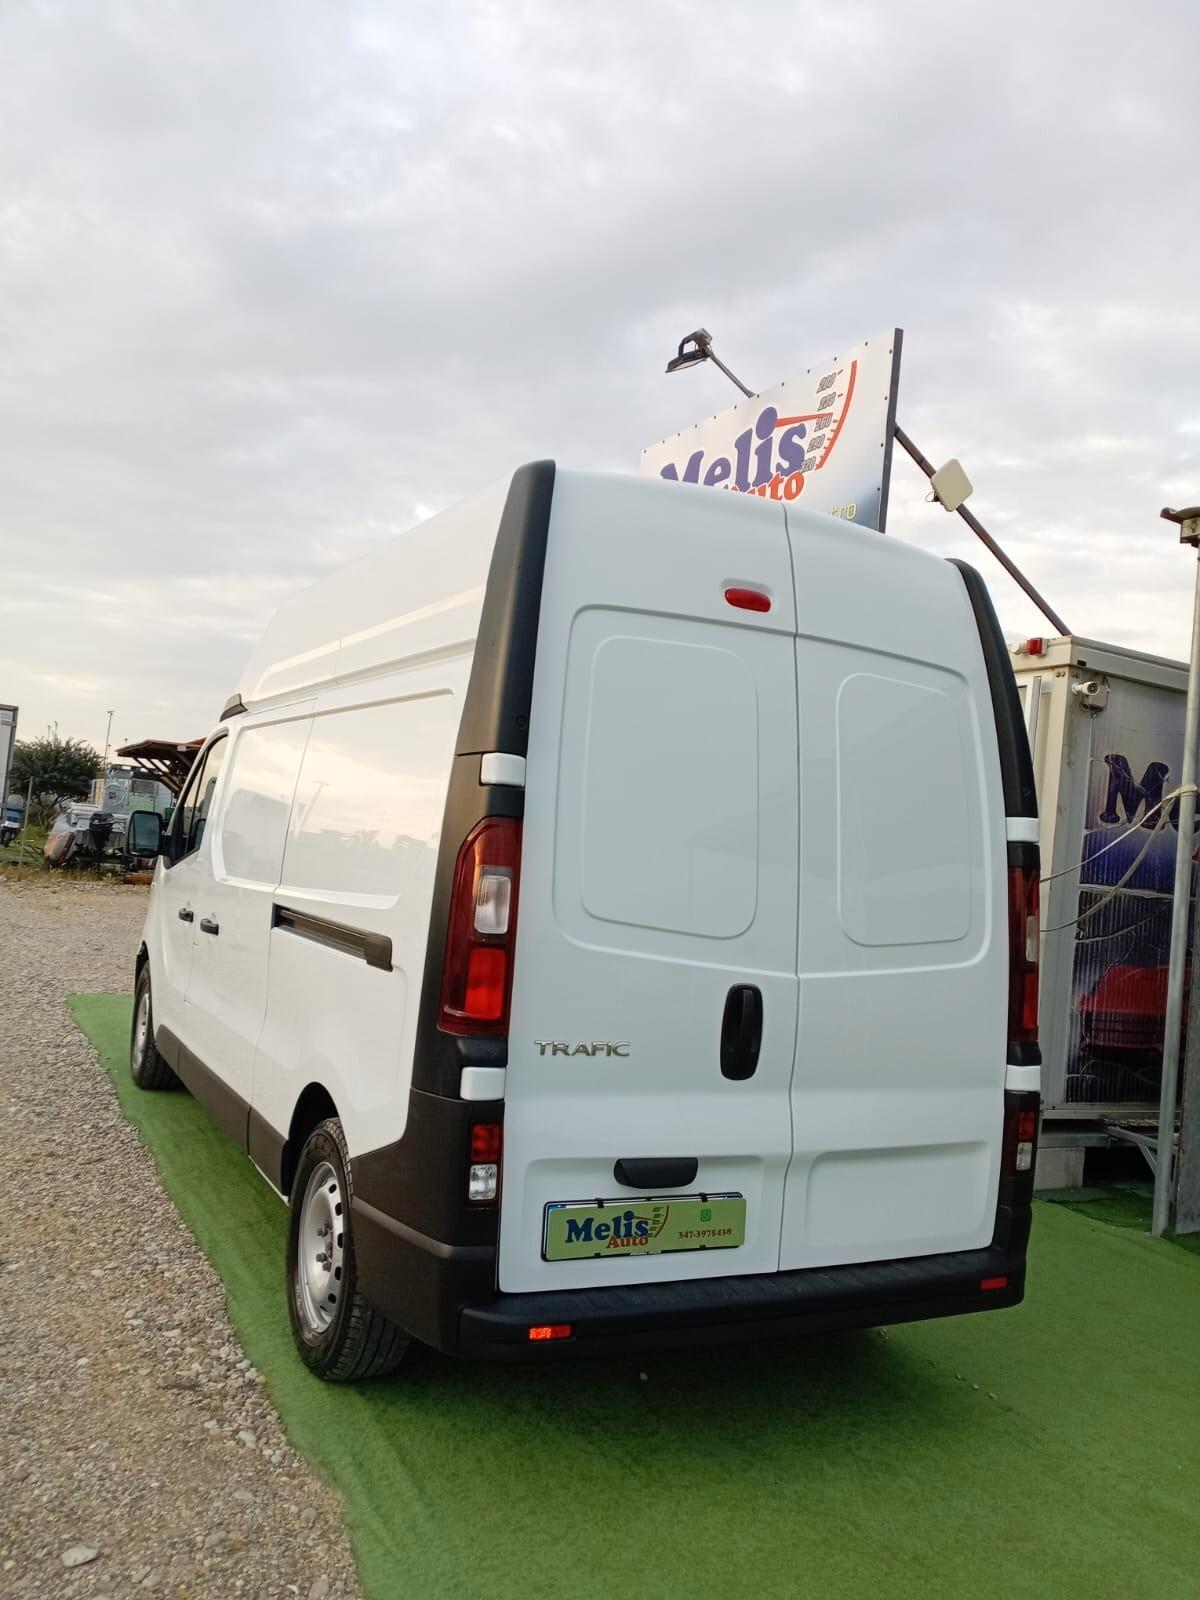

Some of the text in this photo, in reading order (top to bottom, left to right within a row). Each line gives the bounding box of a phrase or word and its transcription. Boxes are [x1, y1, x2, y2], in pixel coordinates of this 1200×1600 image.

[731, 471, 805, 501] uto
[534, 1040, 631, 1057] TRAFIC
[565, 1210, 649, 1243] Melis
[606, 1235, 649, 1248] Auto
